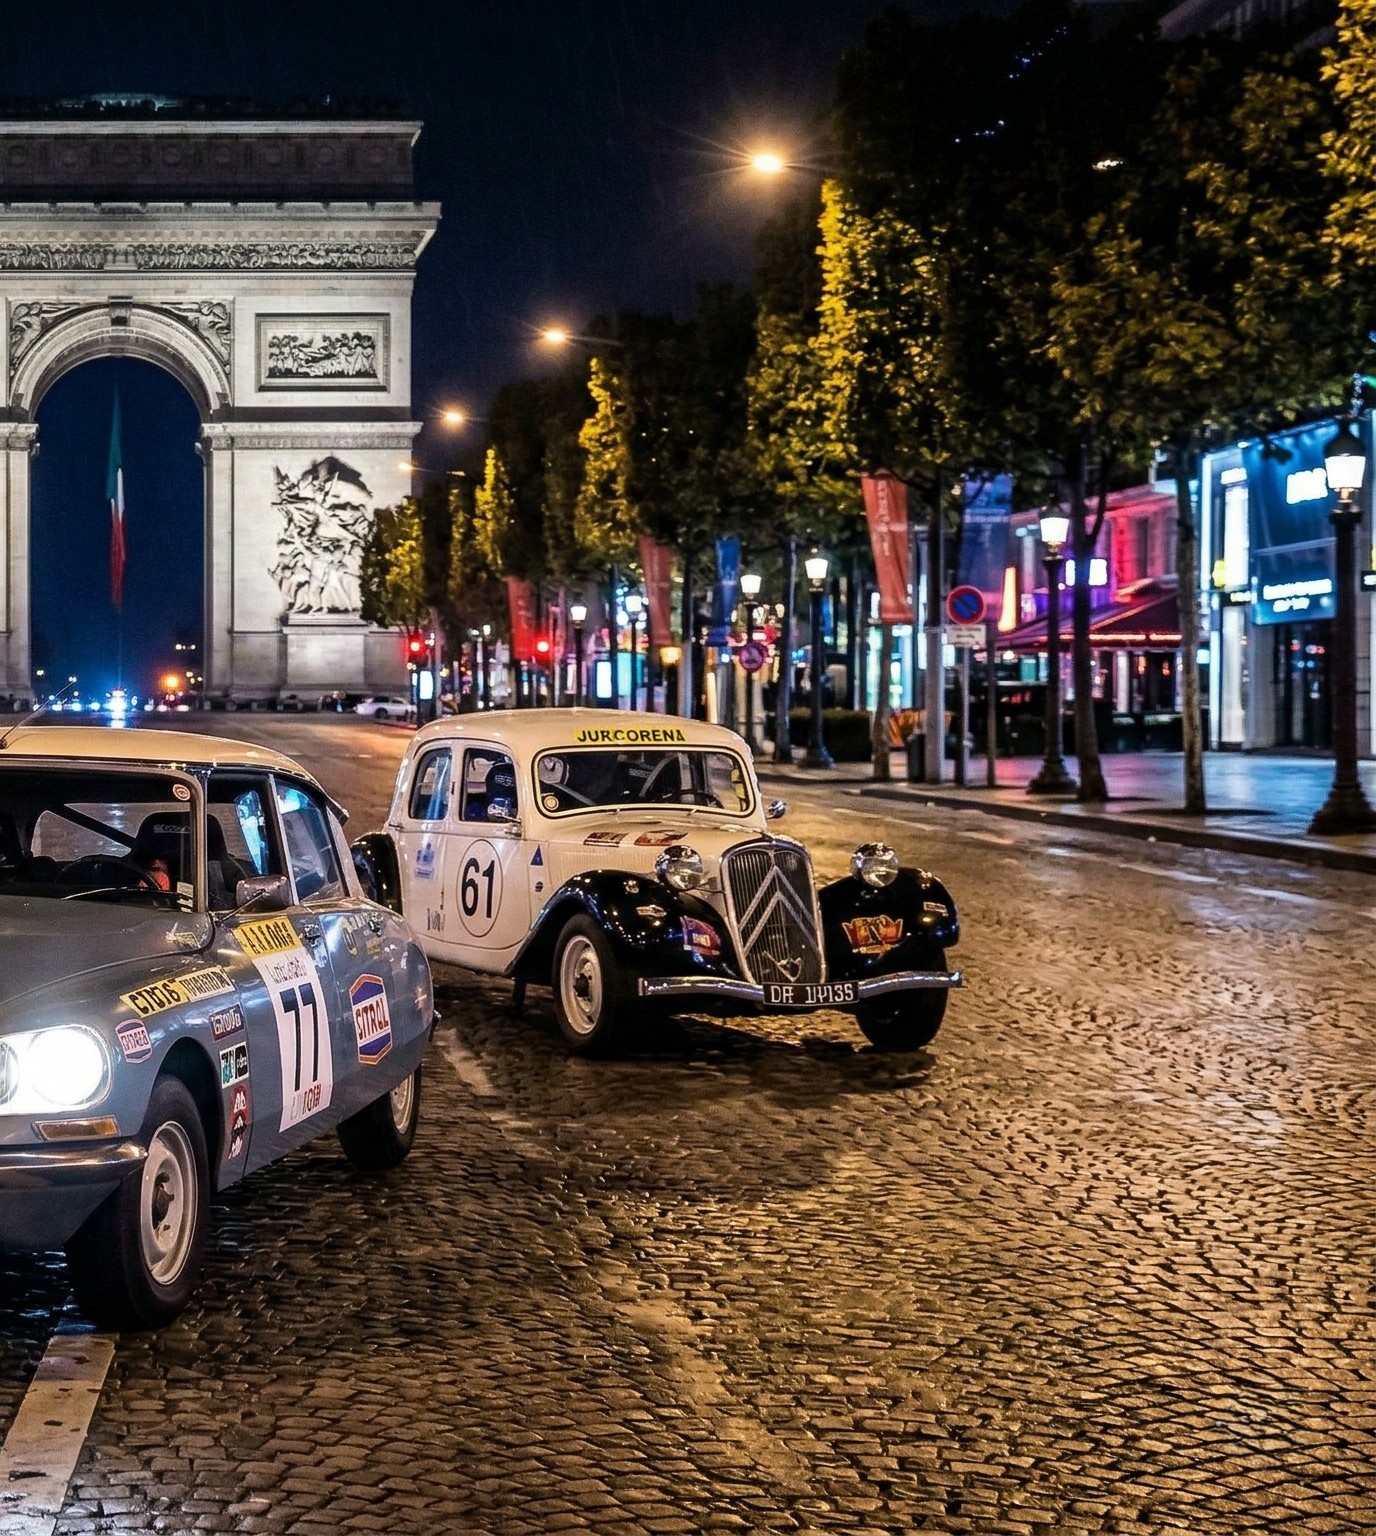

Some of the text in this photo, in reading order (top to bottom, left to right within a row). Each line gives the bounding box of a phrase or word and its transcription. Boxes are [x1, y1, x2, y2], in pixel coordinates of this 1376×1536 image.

[577, 729, 686, 743] JURCORENA
[461, 857, 495, 919] 61
[279, 982, 319, 1092] 77
